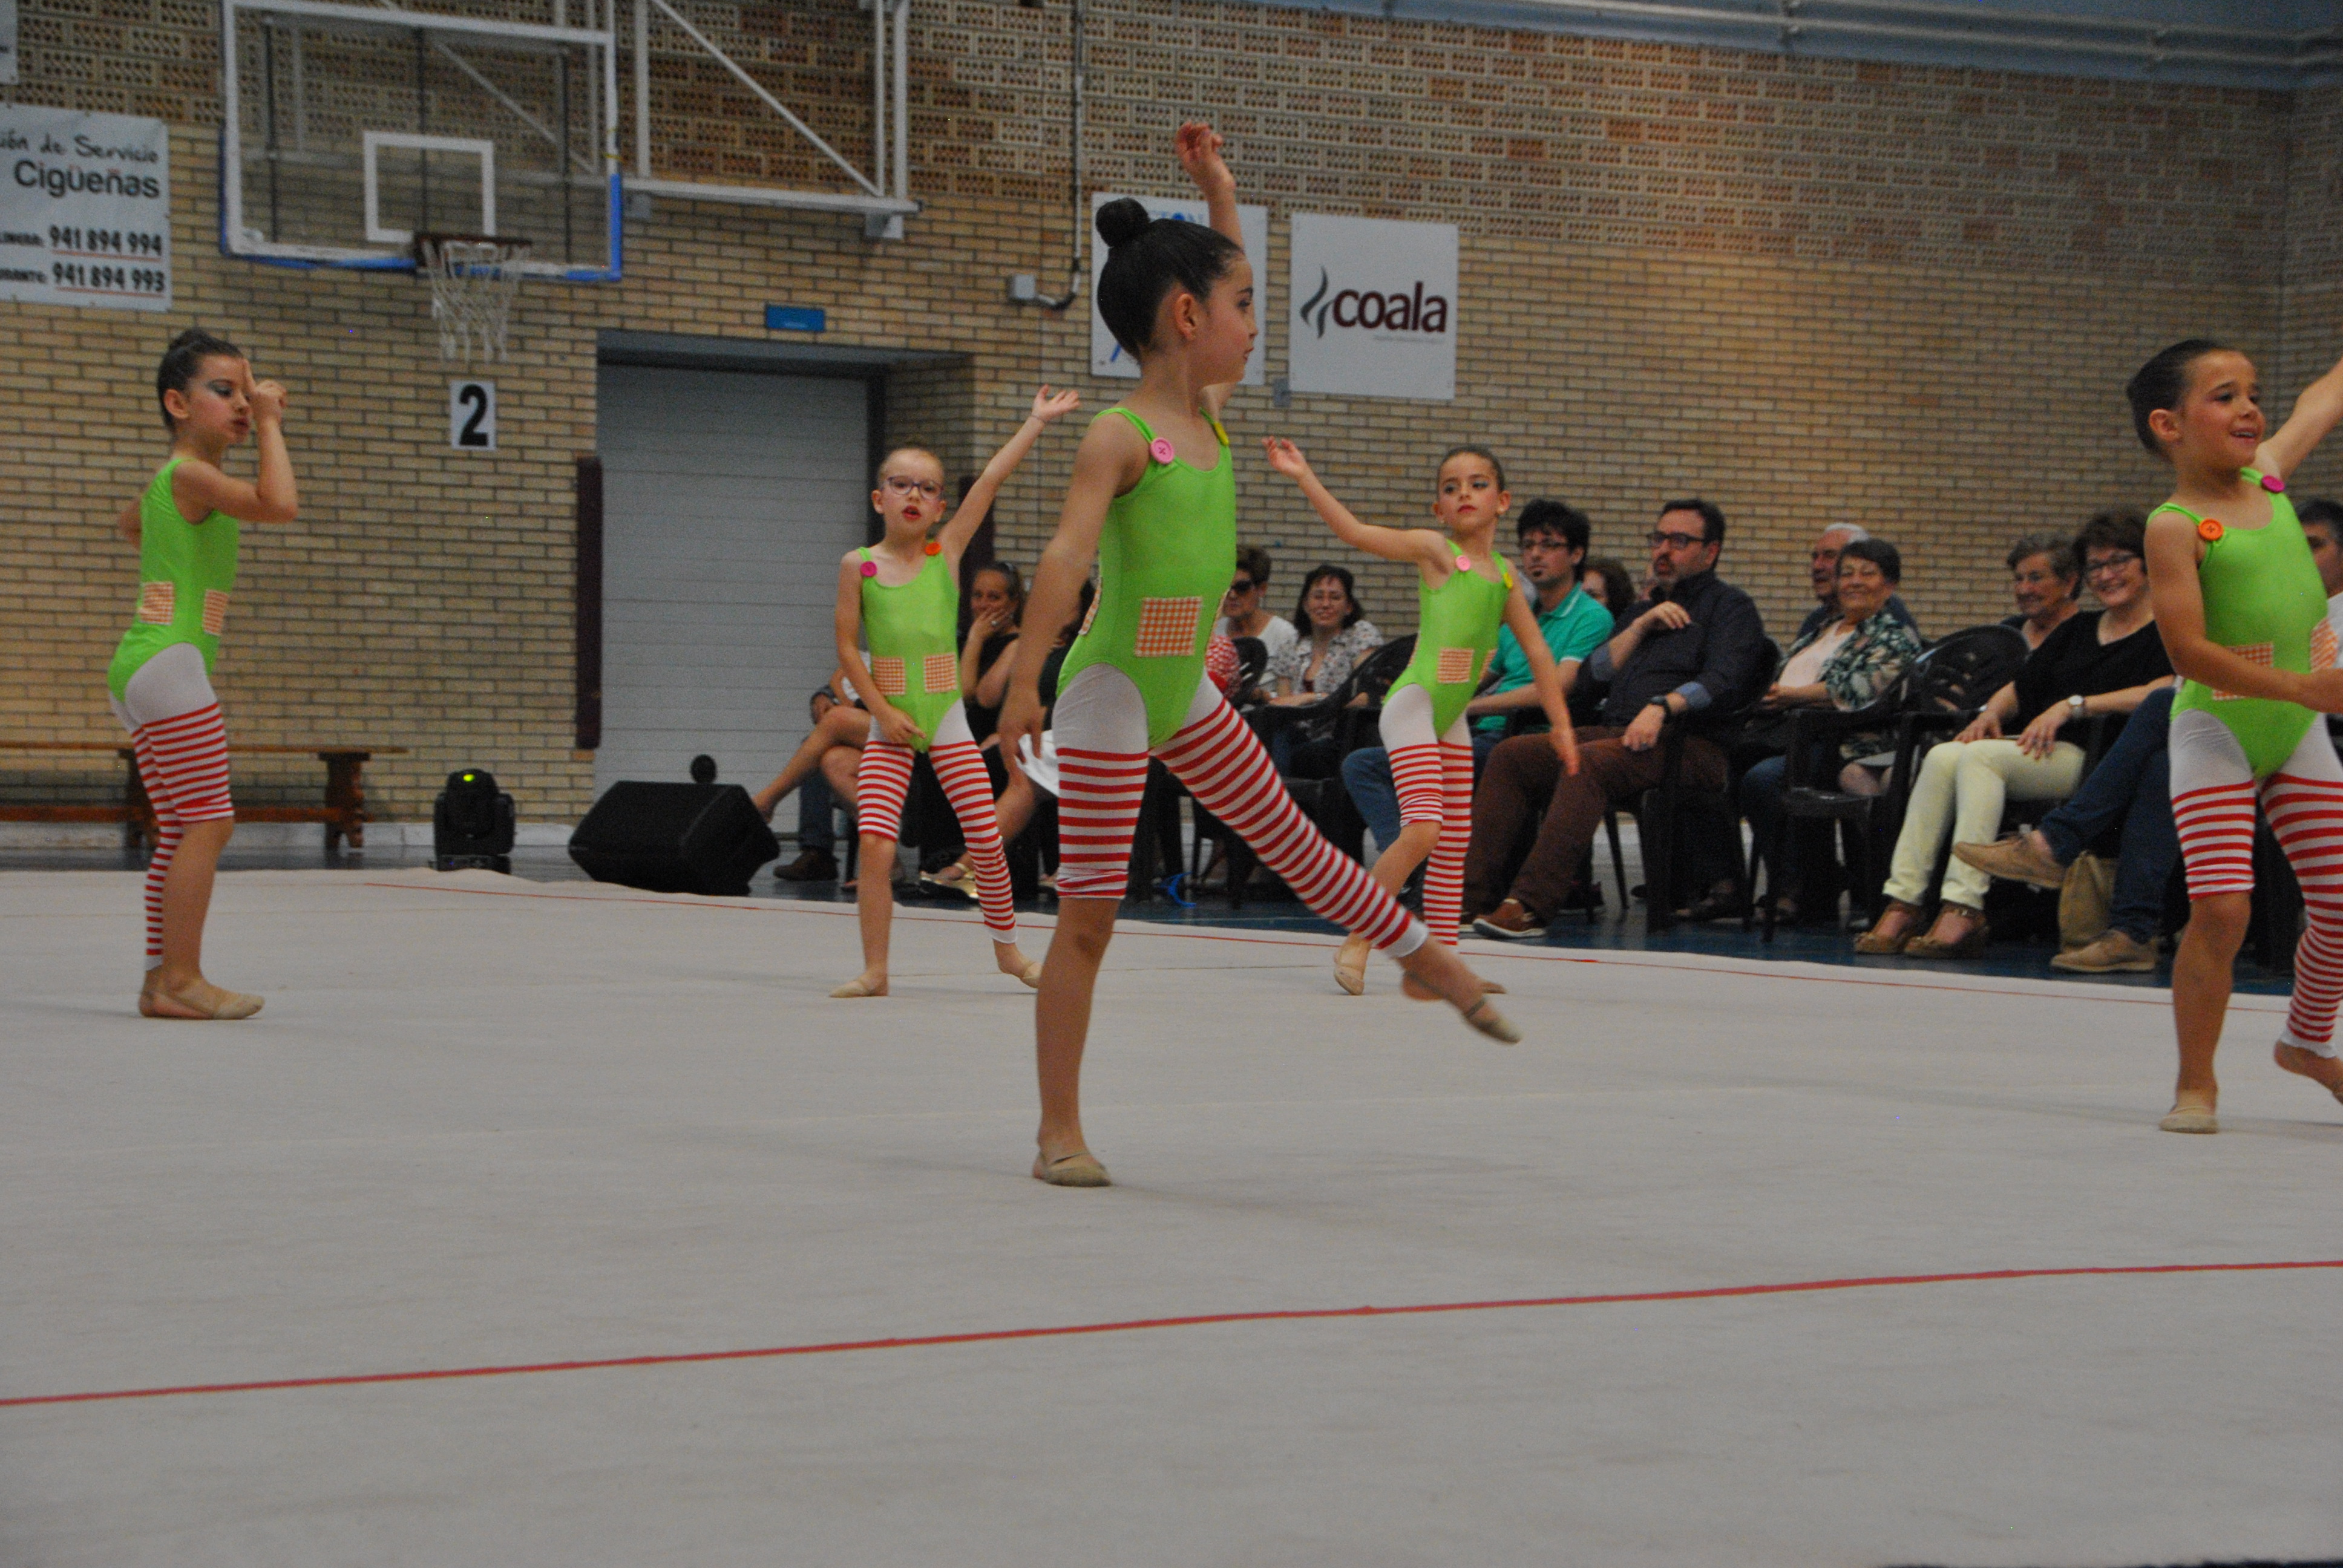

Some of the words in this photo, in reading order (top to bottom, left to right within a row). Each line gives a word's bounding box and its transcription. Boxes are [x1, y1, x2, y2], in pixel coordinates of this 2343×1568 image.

[41, 134, 67, 155] de
[74, 134, 159, 163] Servicio
[14, 159, 160, 198] Cigüeñas
[50, 224, 80, 249] 941
[87, 229, 122, 252] 894
[128, 232, 162, 255] 994
[53, 261, 84, 285] 941
[91, 265, 125, 289] 894
[132, 269, 165, 293] 993
[1333, 281, 1447, 333] coala
[459, 384, 488, 445] 2
